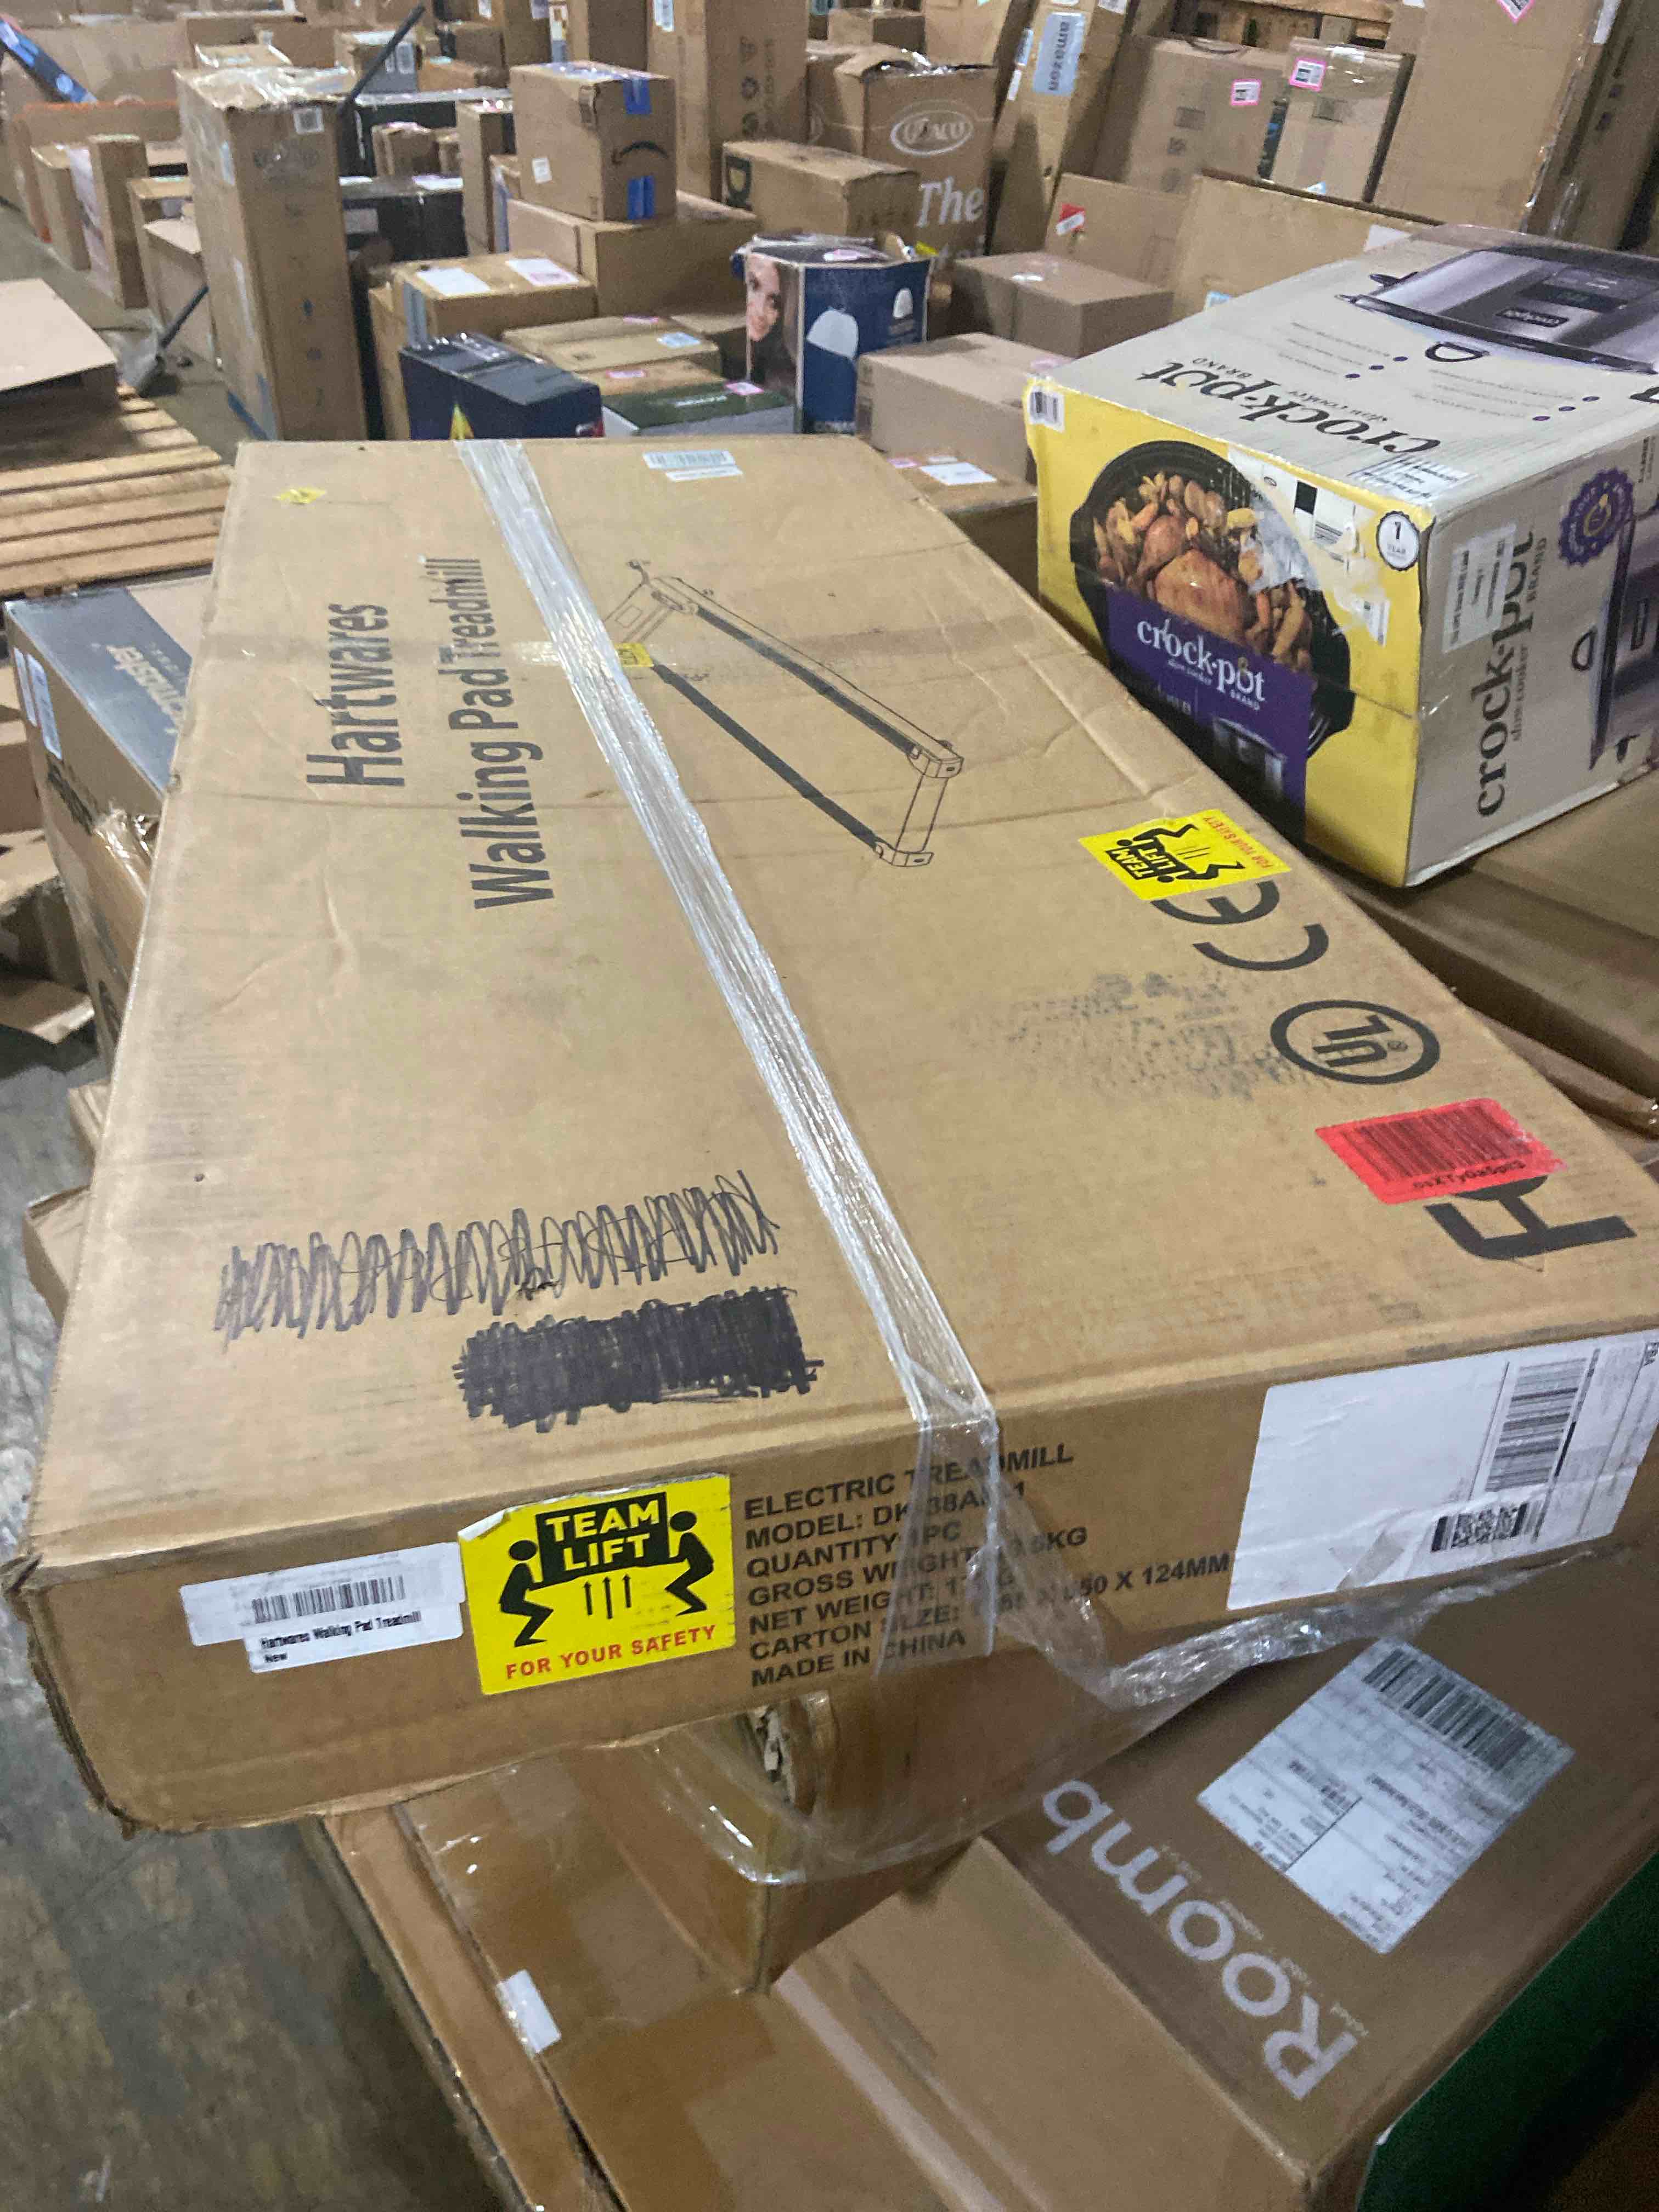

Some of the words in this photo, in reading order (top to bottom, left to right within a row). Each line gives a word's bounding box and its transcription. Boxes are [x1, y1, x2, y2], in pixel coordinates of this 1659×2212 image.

[917, 176, 984, 228] The
[424, 558, 500, 664] Treadmill
[306, 603, 405, 786] Hartwares
[438, 668, 519, 730] Pad
[456, 741, 554, 909] Walking
[1111, 848, 1155, 878] TEAM
[1137, 847, 1176, 870] LIFT
[545, 1499, 660, 1542] TEAM
[744, 1473, 896, 1520] ELECTRIC
[562, 1533, 650, 1571] LIFT
[745, 1513, 863, 1550] MODEL:
[747, 1568, 854, 1607] GROSS
[749, 1620, 872, 1661] CARTON
[1115, 1568, 1135, 1590] X
[1143, 1553, 1231, 1585] 124MM
[749, 1607, 806, 1636] NET
[505, 1657, 551, 1680] FOR
[560, 1644, 623, 1671] YOUR
[631, 1624, 716, 1655] SAFETY
[752, 1654, 834, 1688] MADE
[843, 1646, 871, 1668] IN
[883, 1628, 967, 1660] CHINA
